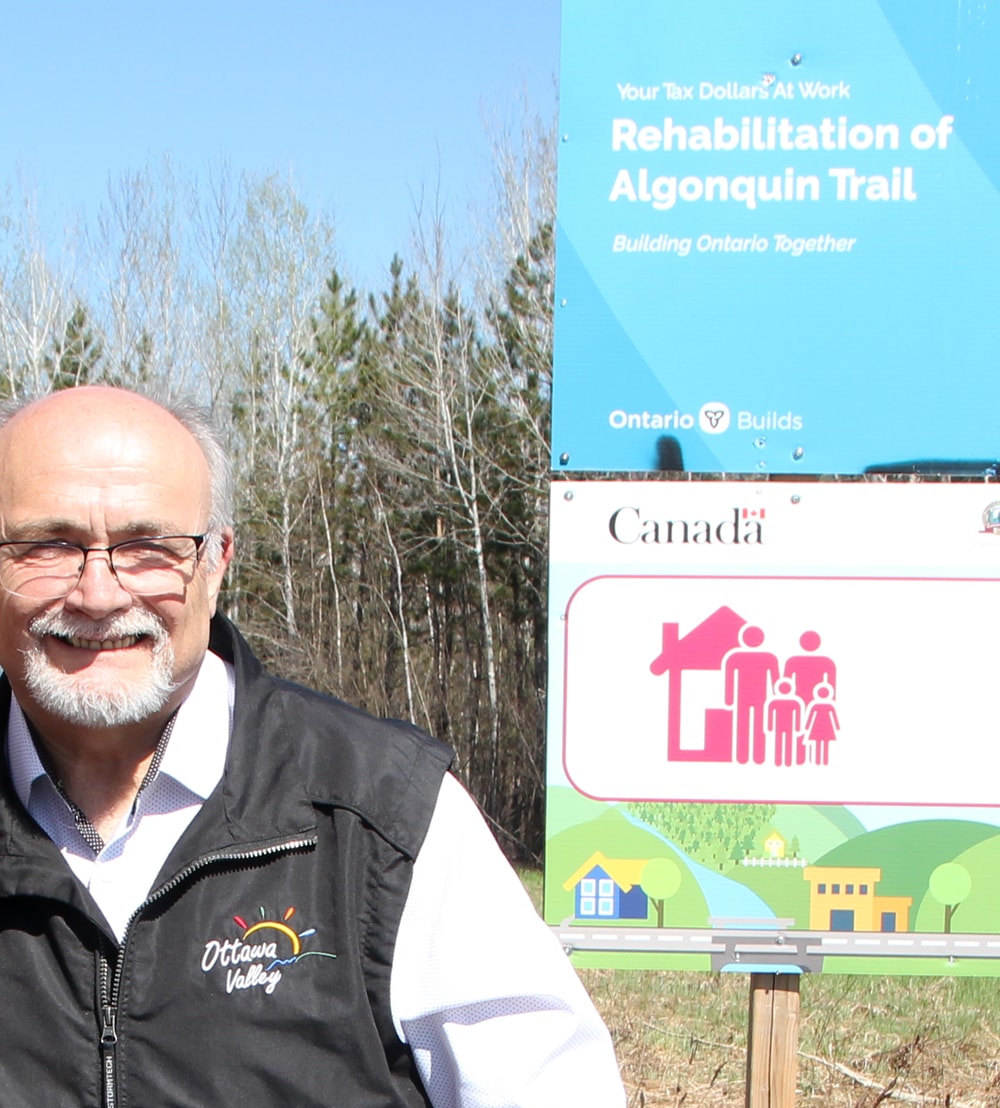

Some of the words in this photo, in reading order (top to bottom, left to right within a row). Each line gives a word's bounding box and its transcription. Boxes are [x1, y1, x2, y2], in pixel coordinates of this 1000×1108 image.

[617, 83, 660, 101] Your
[662, 82, 693, 99] Tax
[699, 80, 768, 100] Dollars
[773, 81, 795, 99] At
[798, 80, 851, 99] Work
[611, 116, 900, 152] Rehabilitation
[910, 115, 955, 151] of
[608, 167, 821, 210] Algonquin
[828, 166, 917, 202] Trail
[612, 233, 692, 257] Building
[696, 234, 769, 253] Ontario
[773, 233, 857, 258] Together
[608, 410, 695, 431] Ontario
[737, 410, 803, 431] Builds
[608, 506, 766, 545] Canada
[201, 937, 277, 972] Ottawa
[225, 966, 282, 994] Valley
